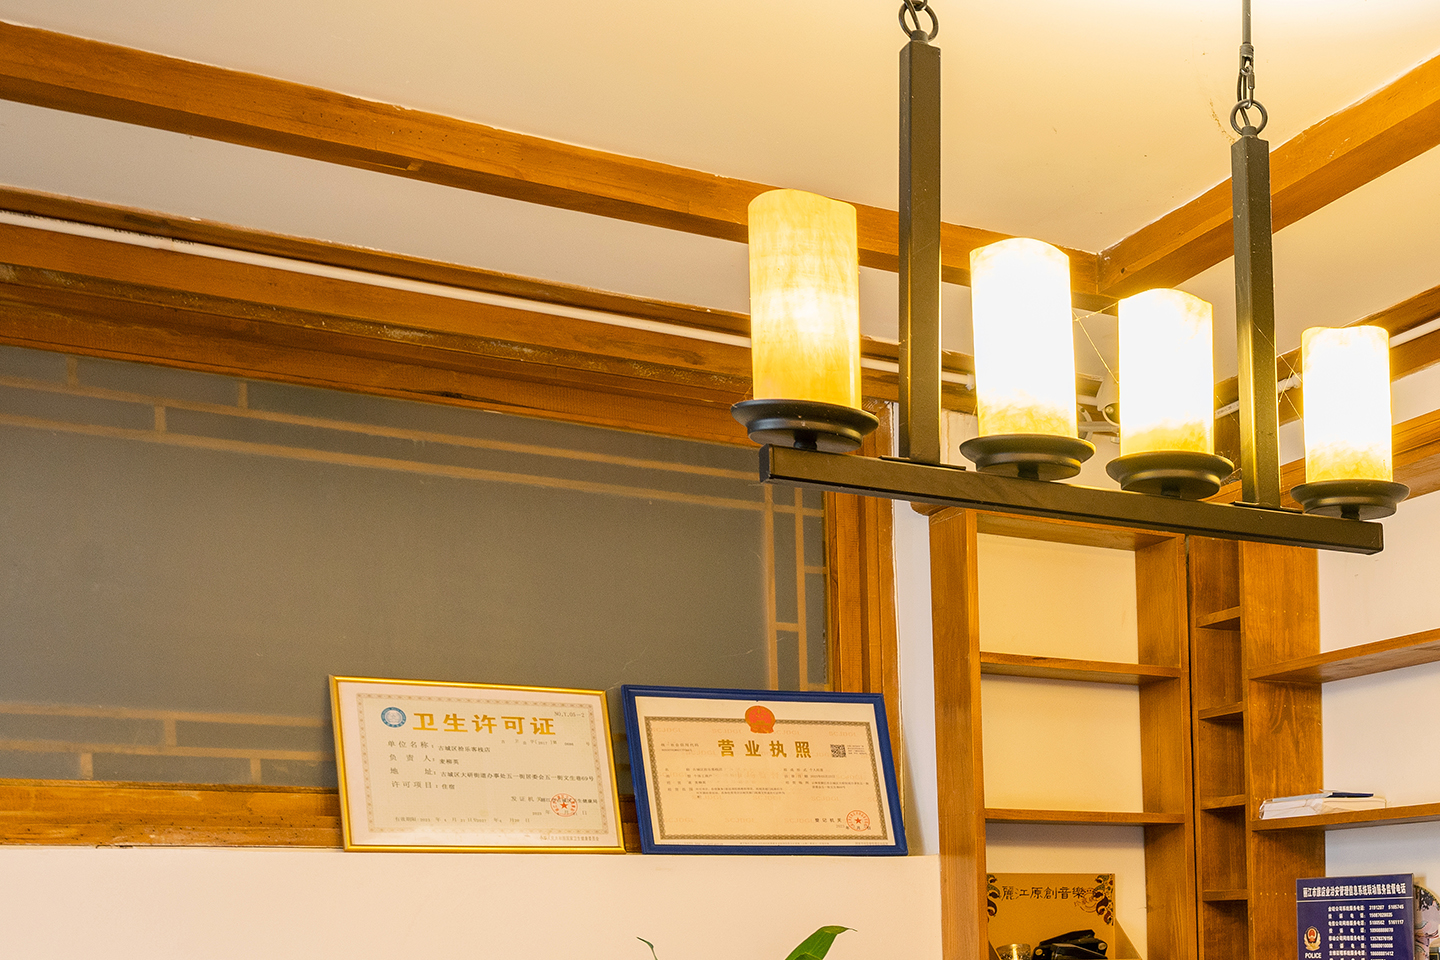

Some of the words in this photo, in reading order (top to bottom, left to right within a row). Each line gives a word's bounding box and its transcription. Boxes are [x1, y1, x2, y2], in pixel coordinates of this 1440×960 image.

[412, 712, 557, 737] 卫生许可证
[718, 739, 812, 759] 营业执照
